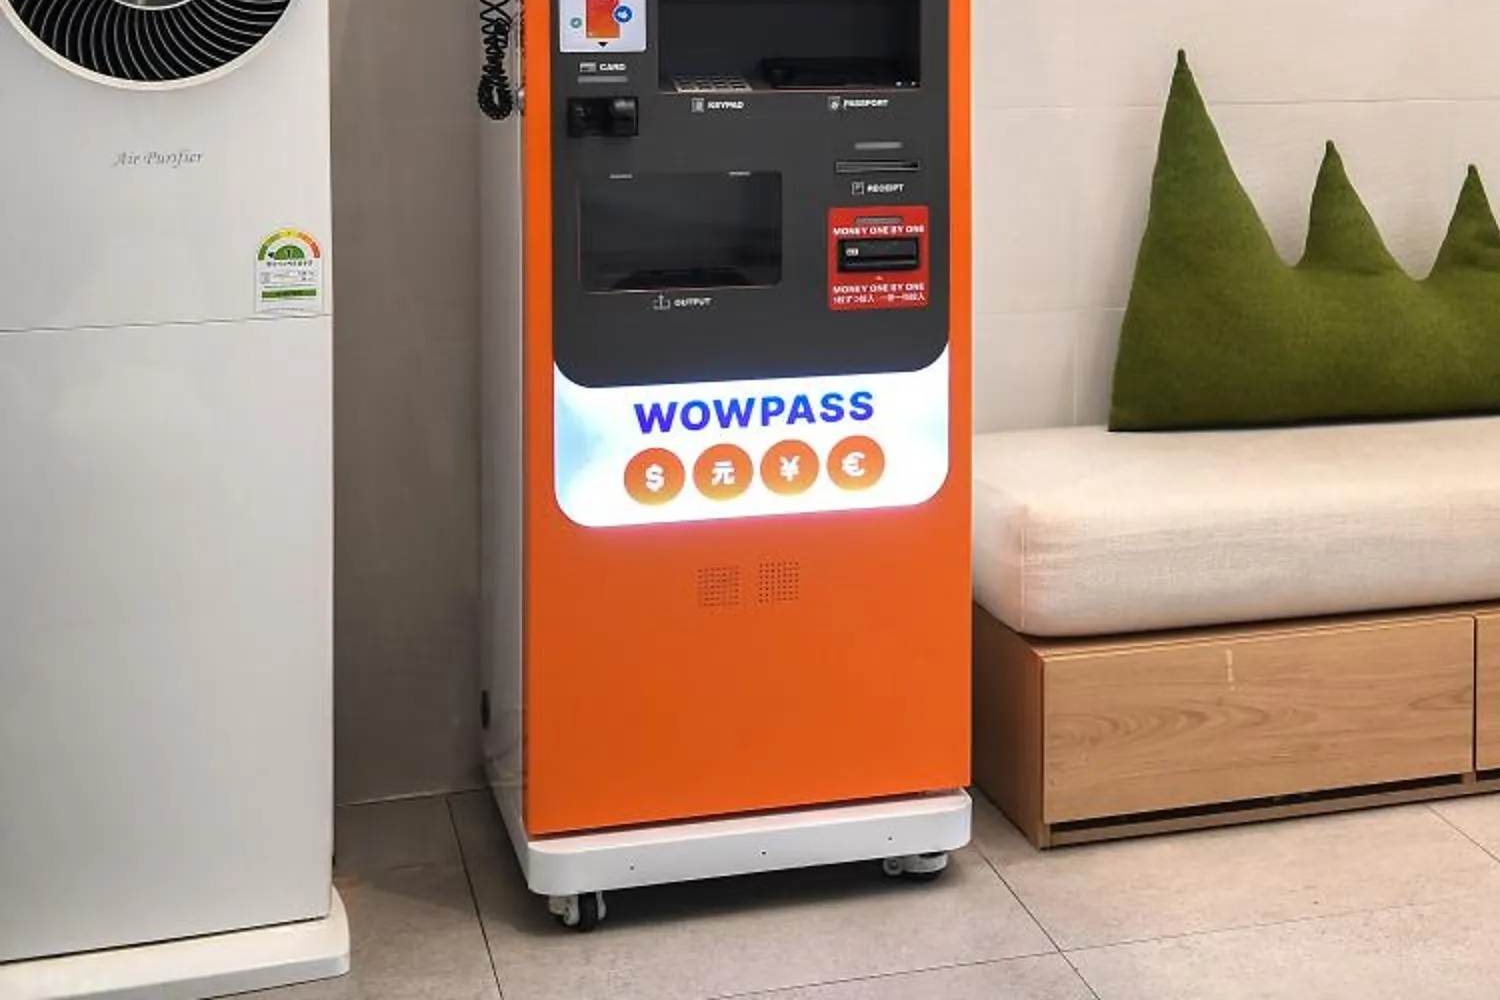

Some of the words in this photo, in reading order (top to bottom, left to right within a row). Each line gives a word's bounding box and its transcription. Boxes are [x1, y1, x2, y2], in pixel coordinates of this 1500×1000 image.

[599, 63, 626, 72] CARD
[707, 100, 745, 110] KEYPAD
[843, 98, 889, 109] PASSPORT
[833, 226, 868, 236] MONEY
[833, 284, 868, 294] MONEY
[674, 297, 712, 307] OUTPUT
[633, 390, 875, 435] WOWPASS
[644, 463, 665, 493] $
[711, 460, 736, 486] 元
[778, 455, 801, 482] ¥
[841, 451, 867, 477] €
